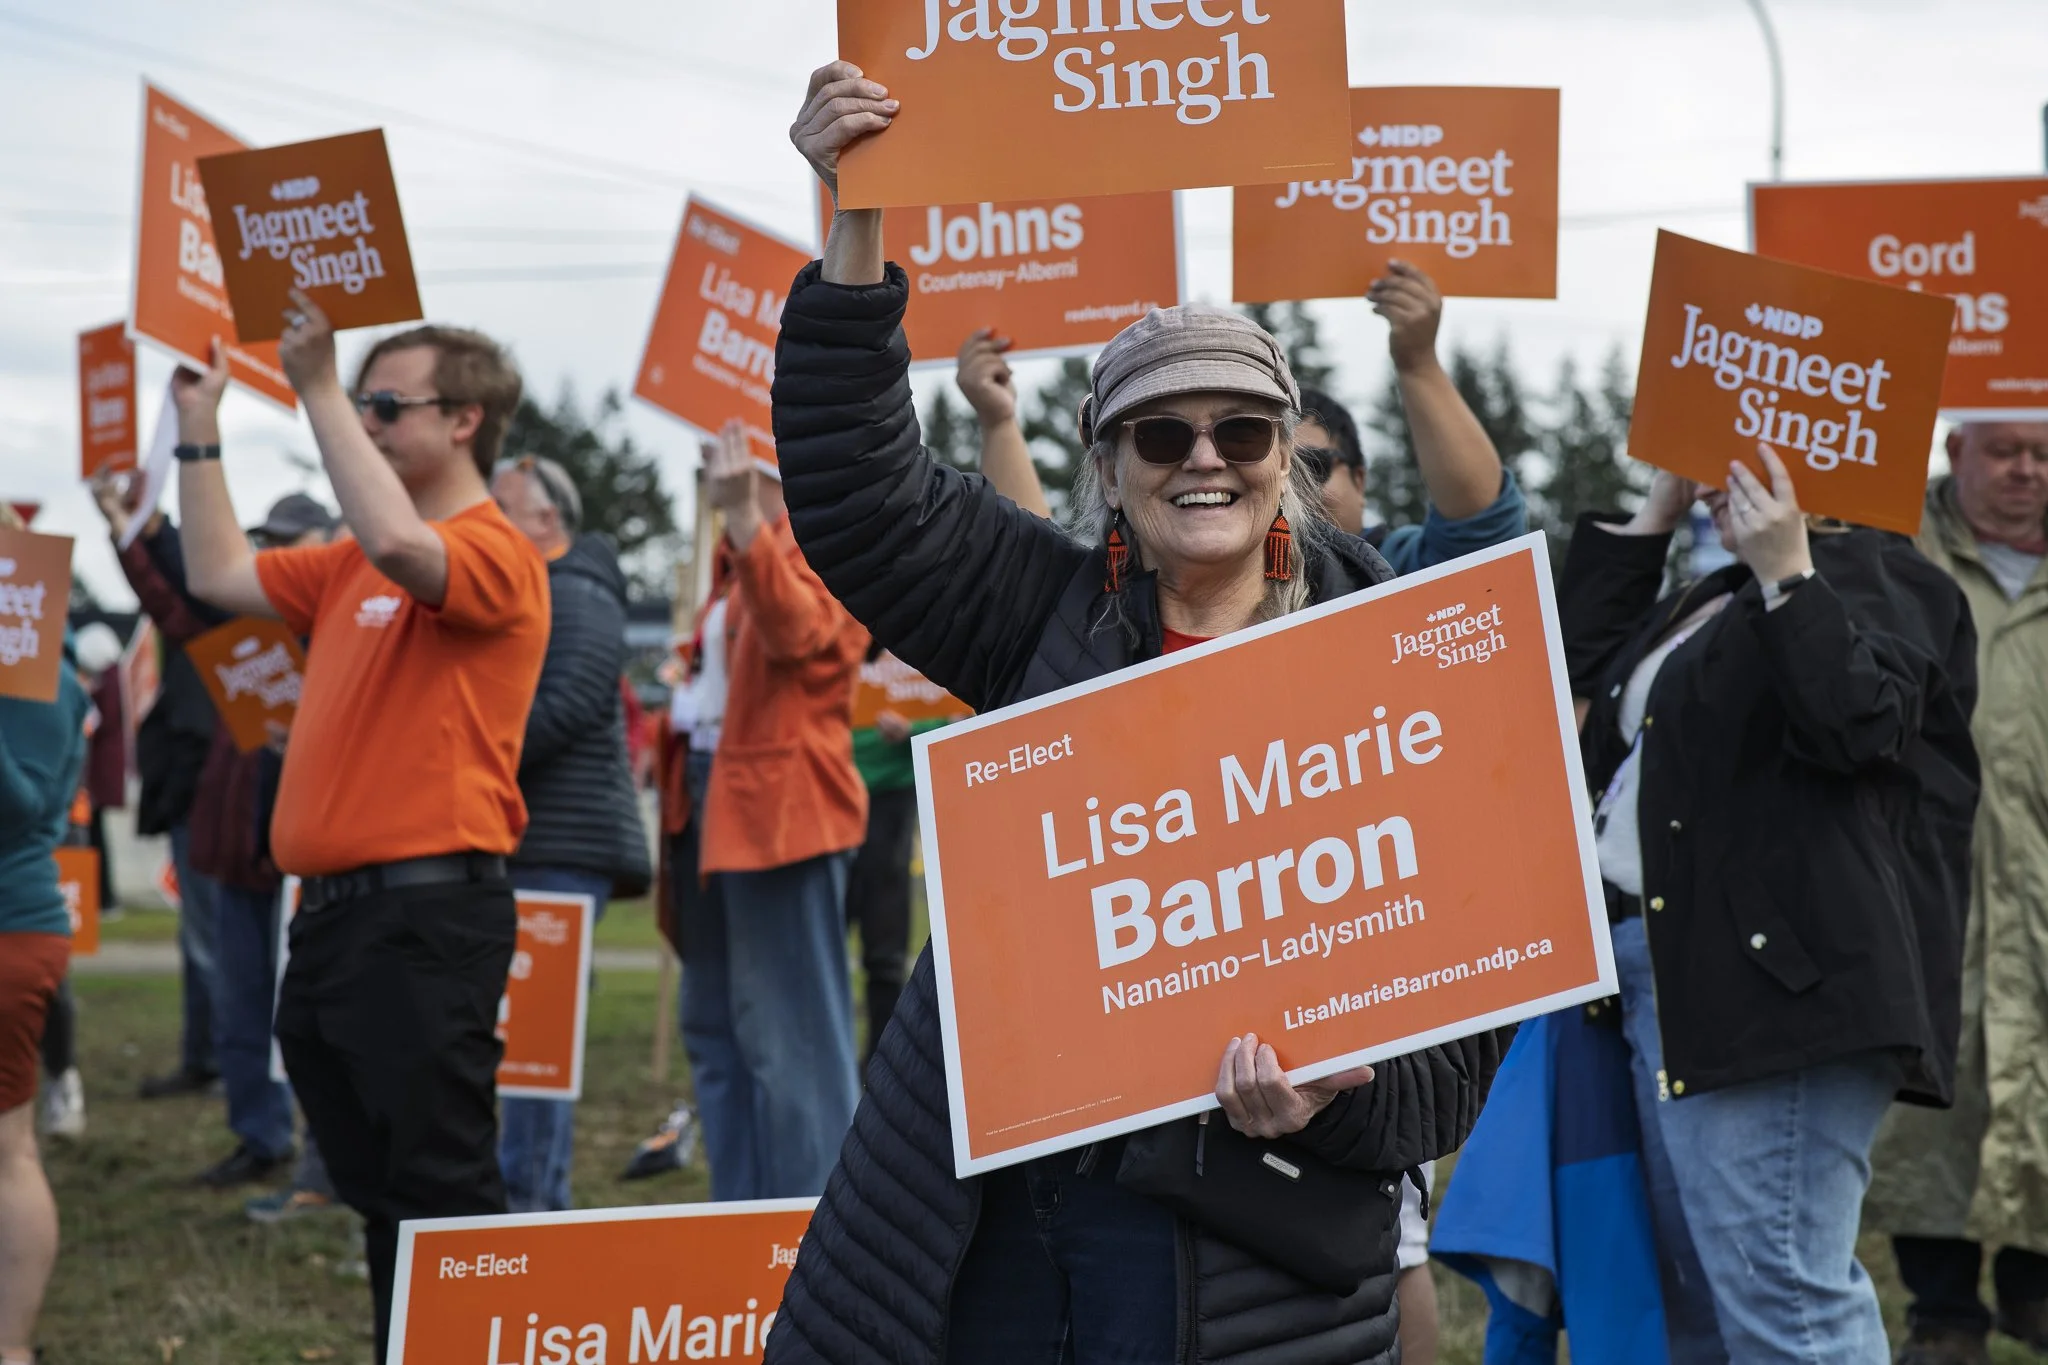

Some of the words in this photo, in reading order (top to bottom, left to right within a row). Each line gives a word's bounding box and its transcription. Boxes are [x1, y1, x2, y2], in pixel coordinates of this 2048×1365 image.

[1053, 32, 1275, 125] Singh
[1379, 125, 1443, 147] NDP
[232, 190, 375, 260] Jagmeet
[909, 202, 1083, 265] Johns
[1365, 196, 1513, 259] Singh
[1868, 230, 1975, 277] Gord
[290, 235, 385, 294] Singh
[1762, 305, 1824, 339] NDP
[1671, 303, 1892, 411] Jagmeet
[1734, 387, 1878, 471] Singh
[1391, 604, 1503, 664] Jagmeet
[1436, 603, 1466, 620] NDP
[1437, 629, 1507, 669] Singh
[965, 733, 1074, 788] Re-Elect
[1041, 797, 1198, 880] Lisa
[1220, 705, 1444, 825] Marie
[1091, 815, 1419, 970] Barron
[1284, 938, 1553, 1030] LisaMarieBarron.ndp.ca
[439, 1253, 529, 1280] Re-Elect
[487, 1312, 608, 1365] Lisa
